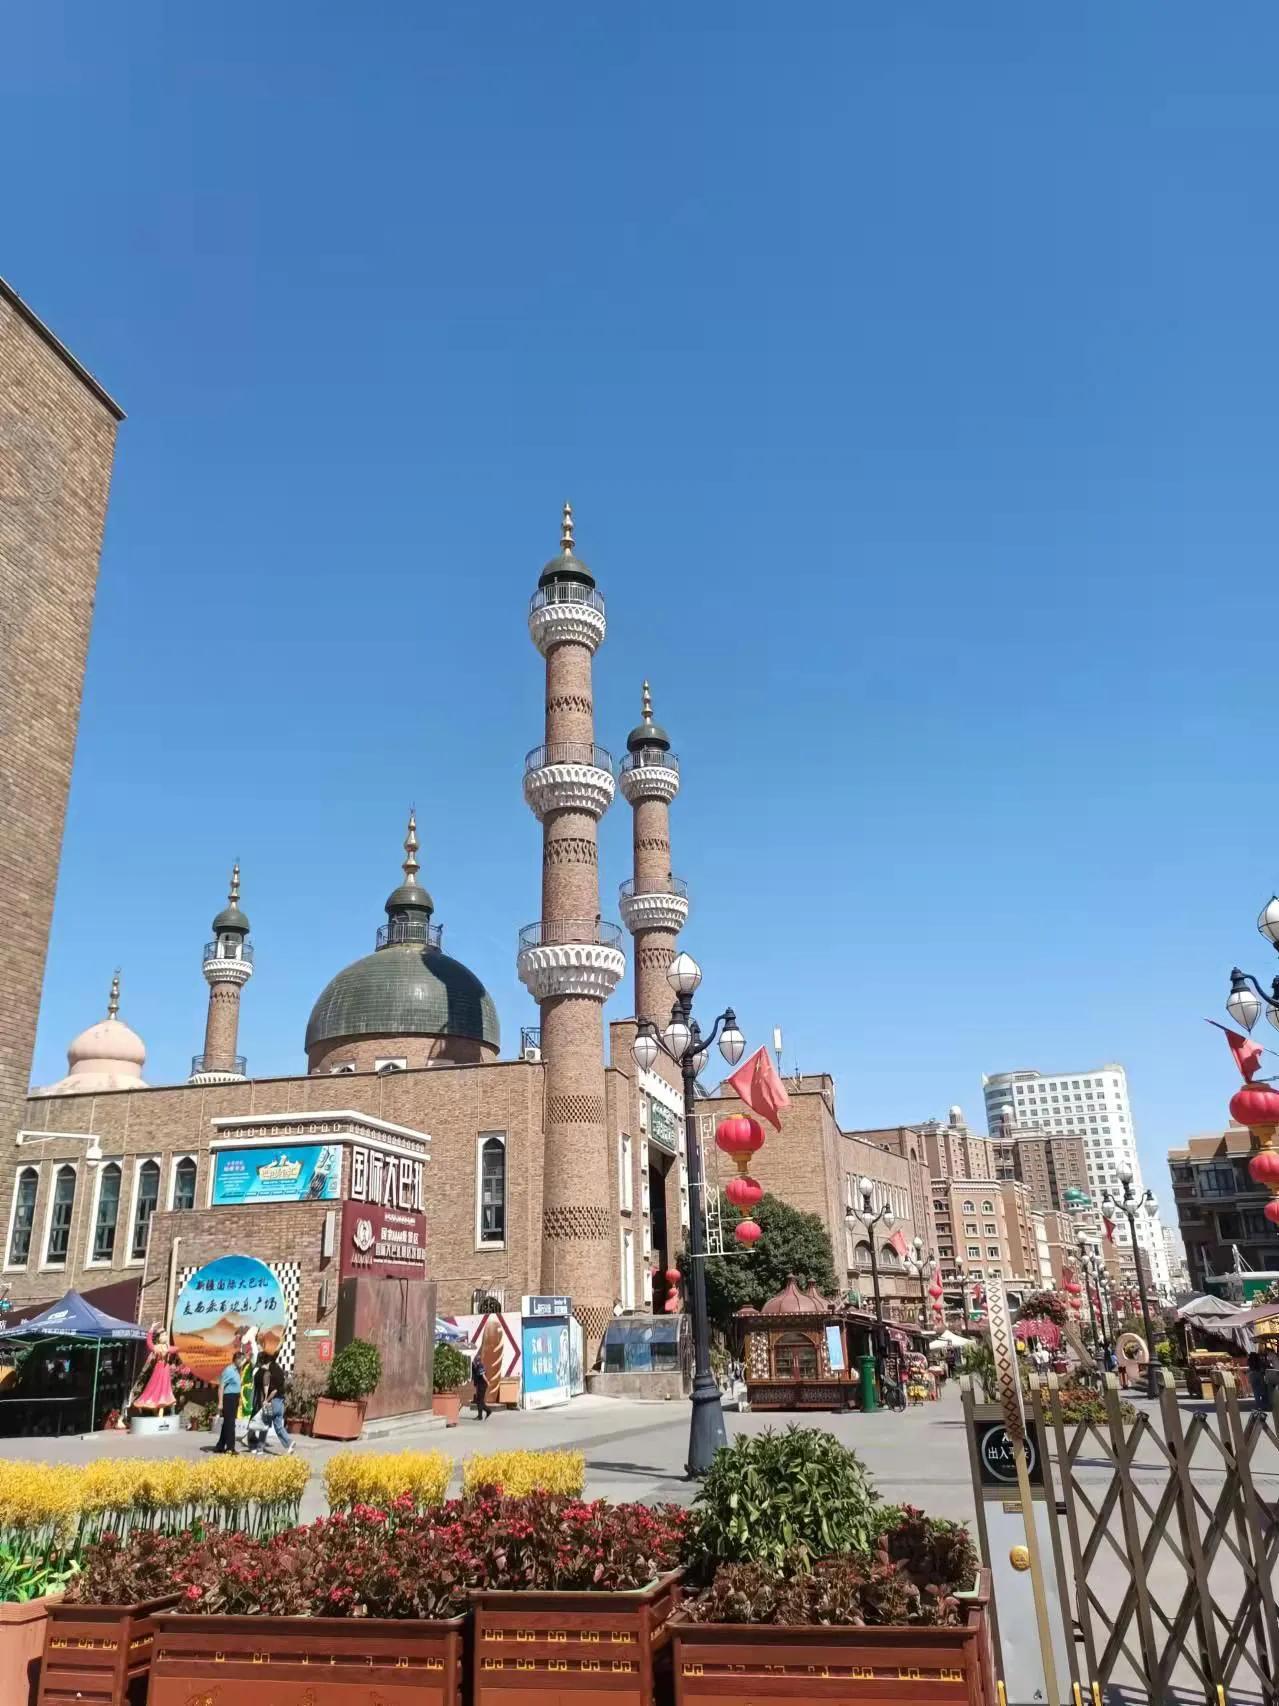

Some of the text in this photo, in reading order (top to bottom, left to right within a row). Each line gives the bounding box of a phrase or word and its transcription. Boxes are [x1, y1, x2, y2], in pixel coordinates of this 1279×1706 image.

[352, 1145, 425, 1210] 国际大巴扎
